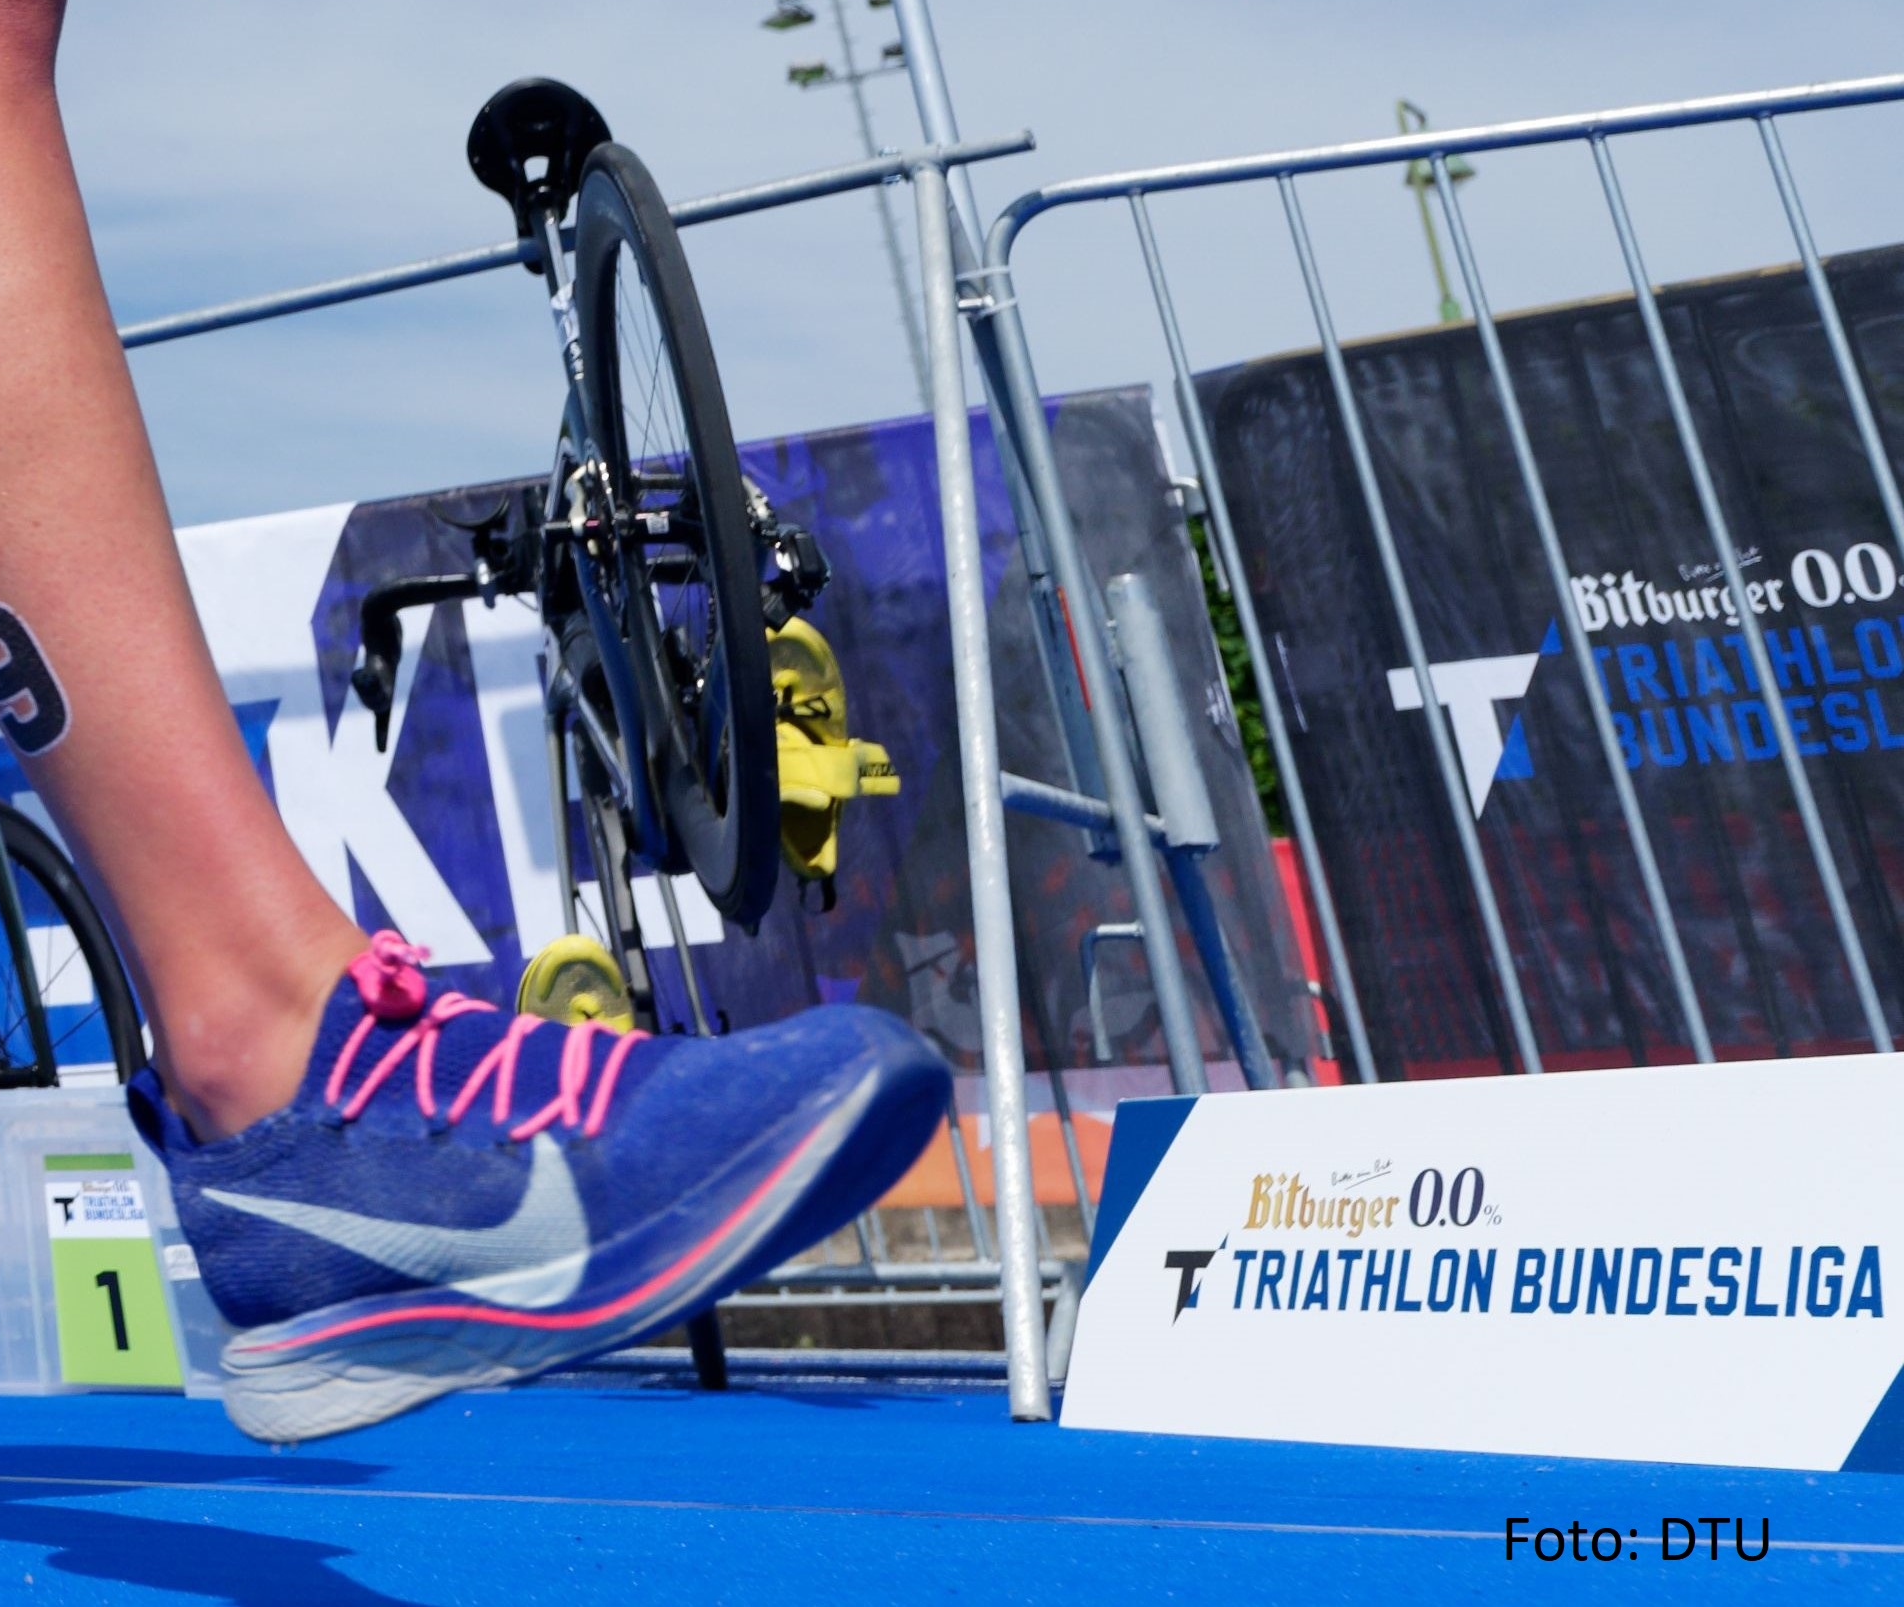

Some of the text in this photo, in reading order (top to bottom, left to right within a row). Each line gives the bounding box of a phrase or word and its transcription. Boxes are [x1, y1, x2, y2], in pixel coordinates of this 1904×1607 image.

[1590, 614, 1904, 706] TRIATHLO
[1243, 1173, 1401, 1239] Bitburger
[95, 1270, 130, 1351] 1
[1232, 1244, 1886, 1319] TRIATHLON BUNDESLIGA
